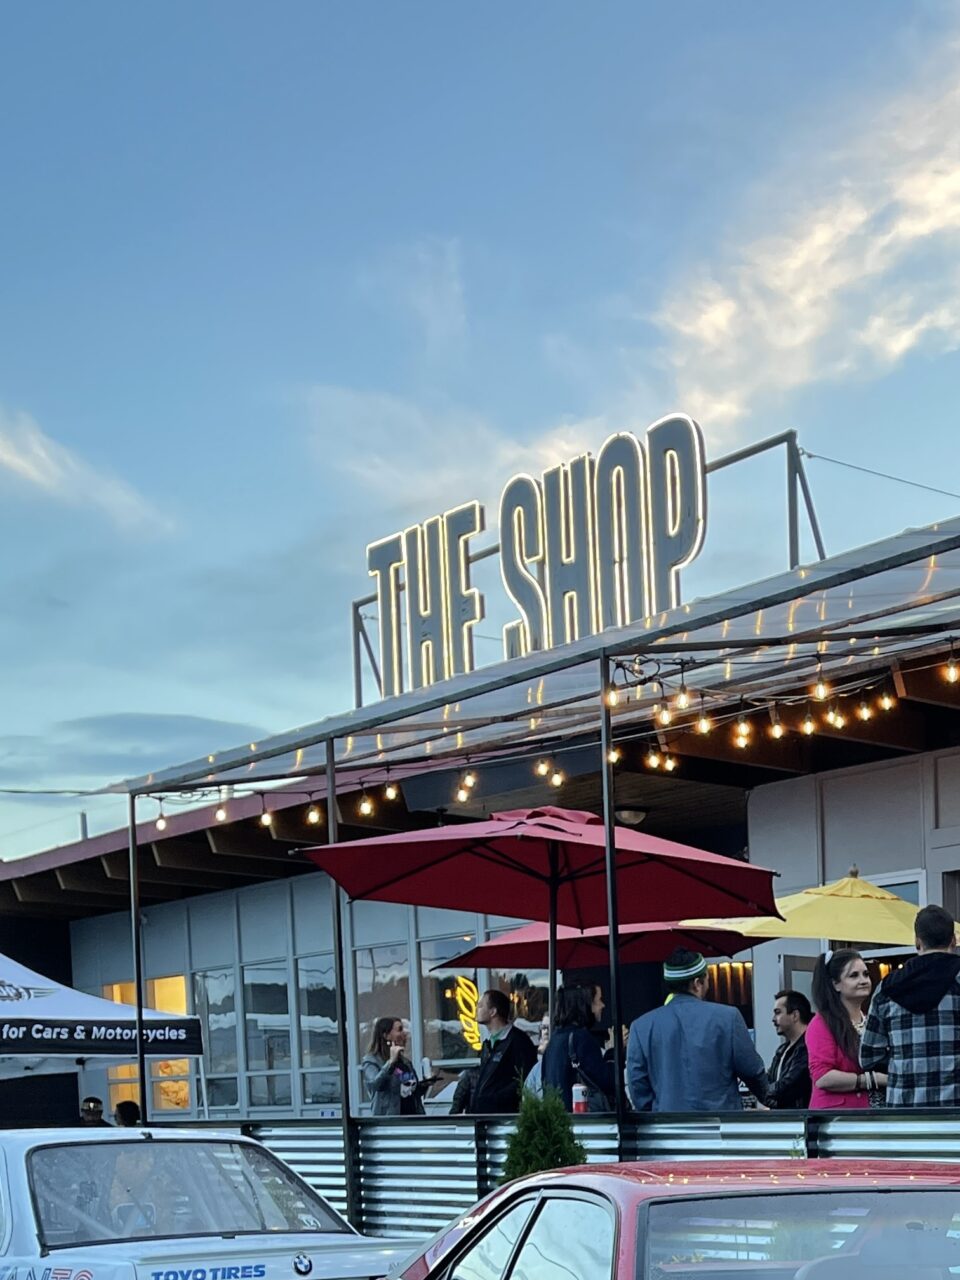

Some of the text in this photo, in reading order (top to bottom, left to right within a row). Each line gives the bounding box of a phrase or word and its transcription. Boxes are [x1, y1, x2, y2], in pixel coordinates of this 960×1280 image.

[366, 412, 708, 699] THE SHOP
[2, 1024, 27, 1039] for
[31, 1024, 69, 1040] Cars
[74, 1026, 87, 1040] &
[209, 1264, 266, 1280] TIRES
